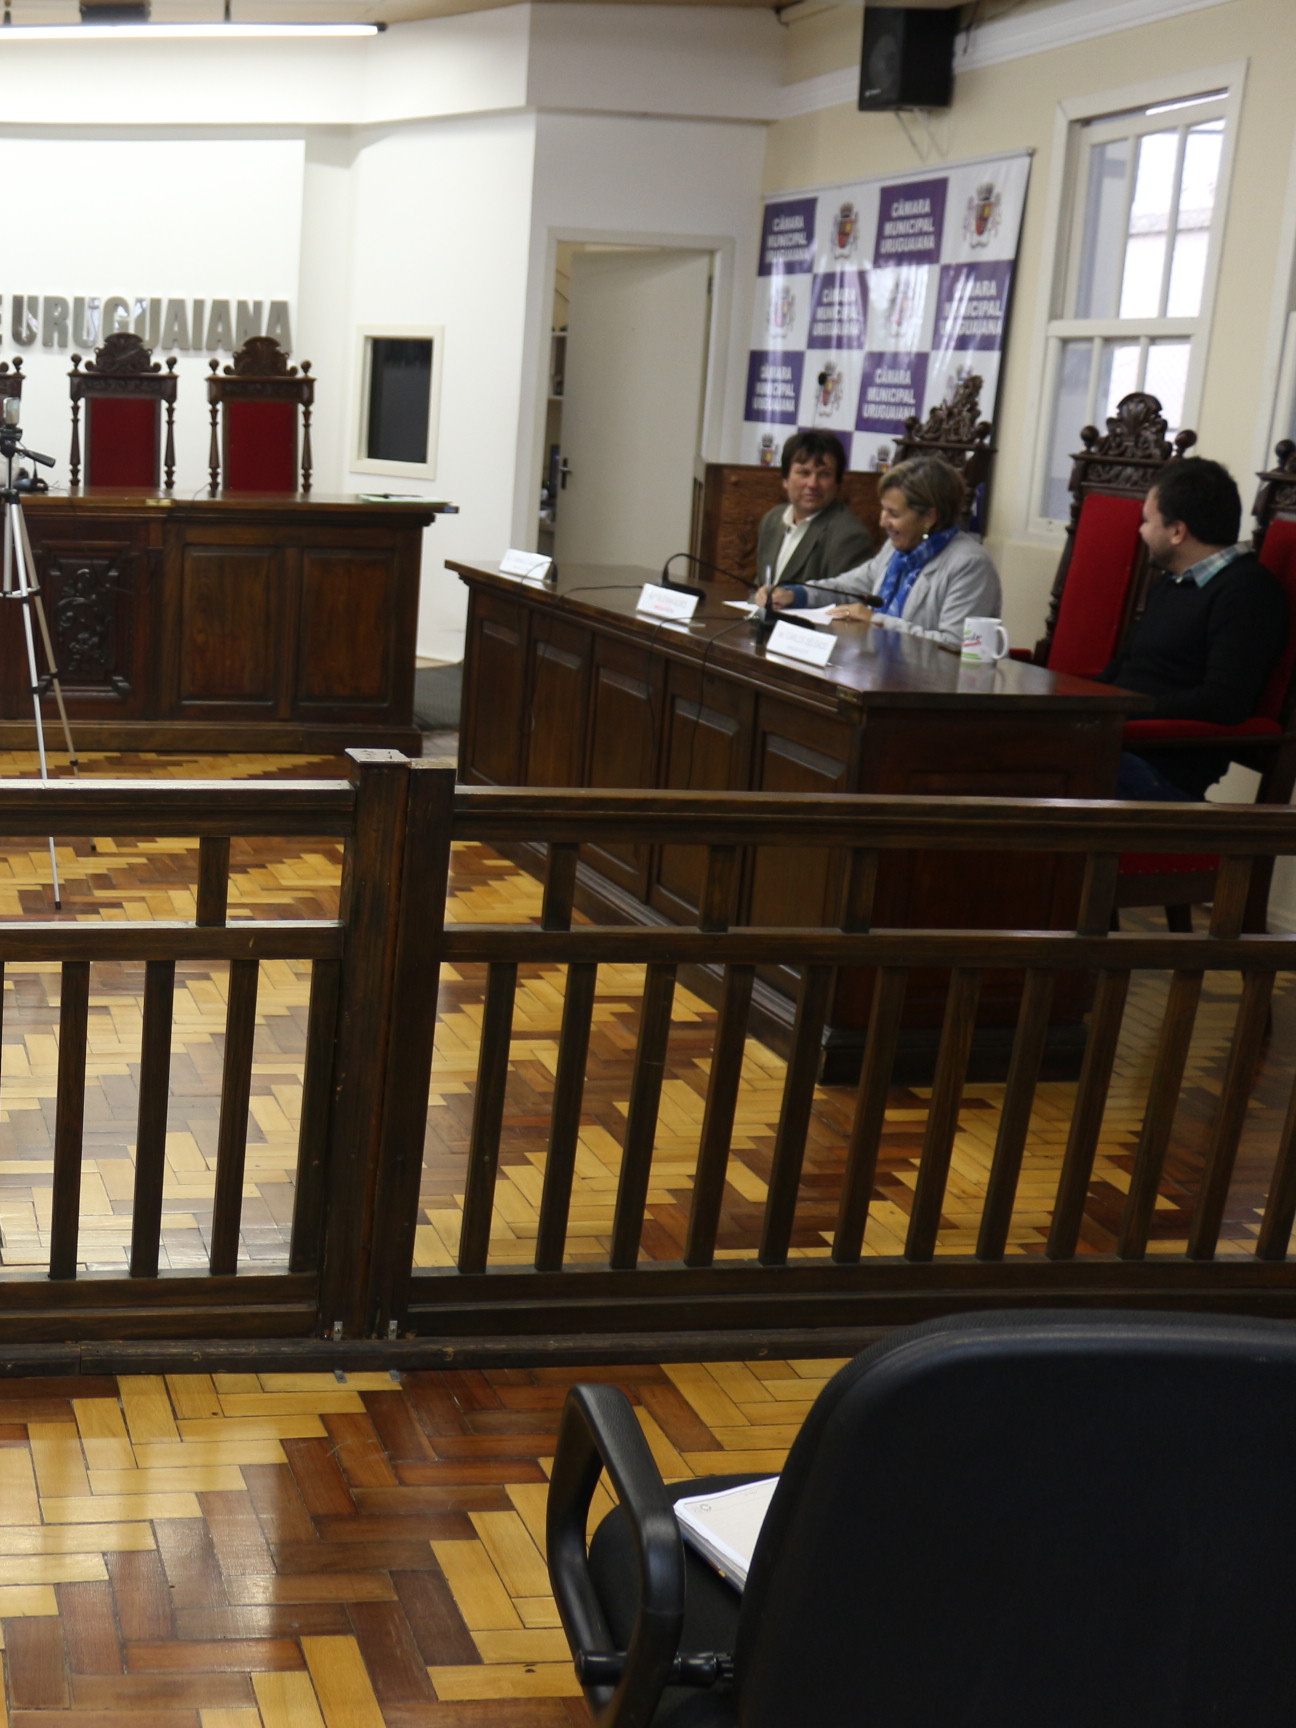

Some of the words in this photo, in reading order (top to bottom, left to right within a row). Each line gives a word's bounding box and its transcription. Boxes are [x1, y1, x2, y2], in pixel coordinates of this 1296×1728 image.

[884, 216, 935, 237] MUNICIPAL
[766, 231, 808, 248] MUNICIPAL
[880, 234, 935, 254] URUGUAIANA
[11, 294, 293, 353] URUGUAIANA
[866, 386, 916, 404] MUNICIPAL
[862, 403, 916, 420] URUGUAIANA
